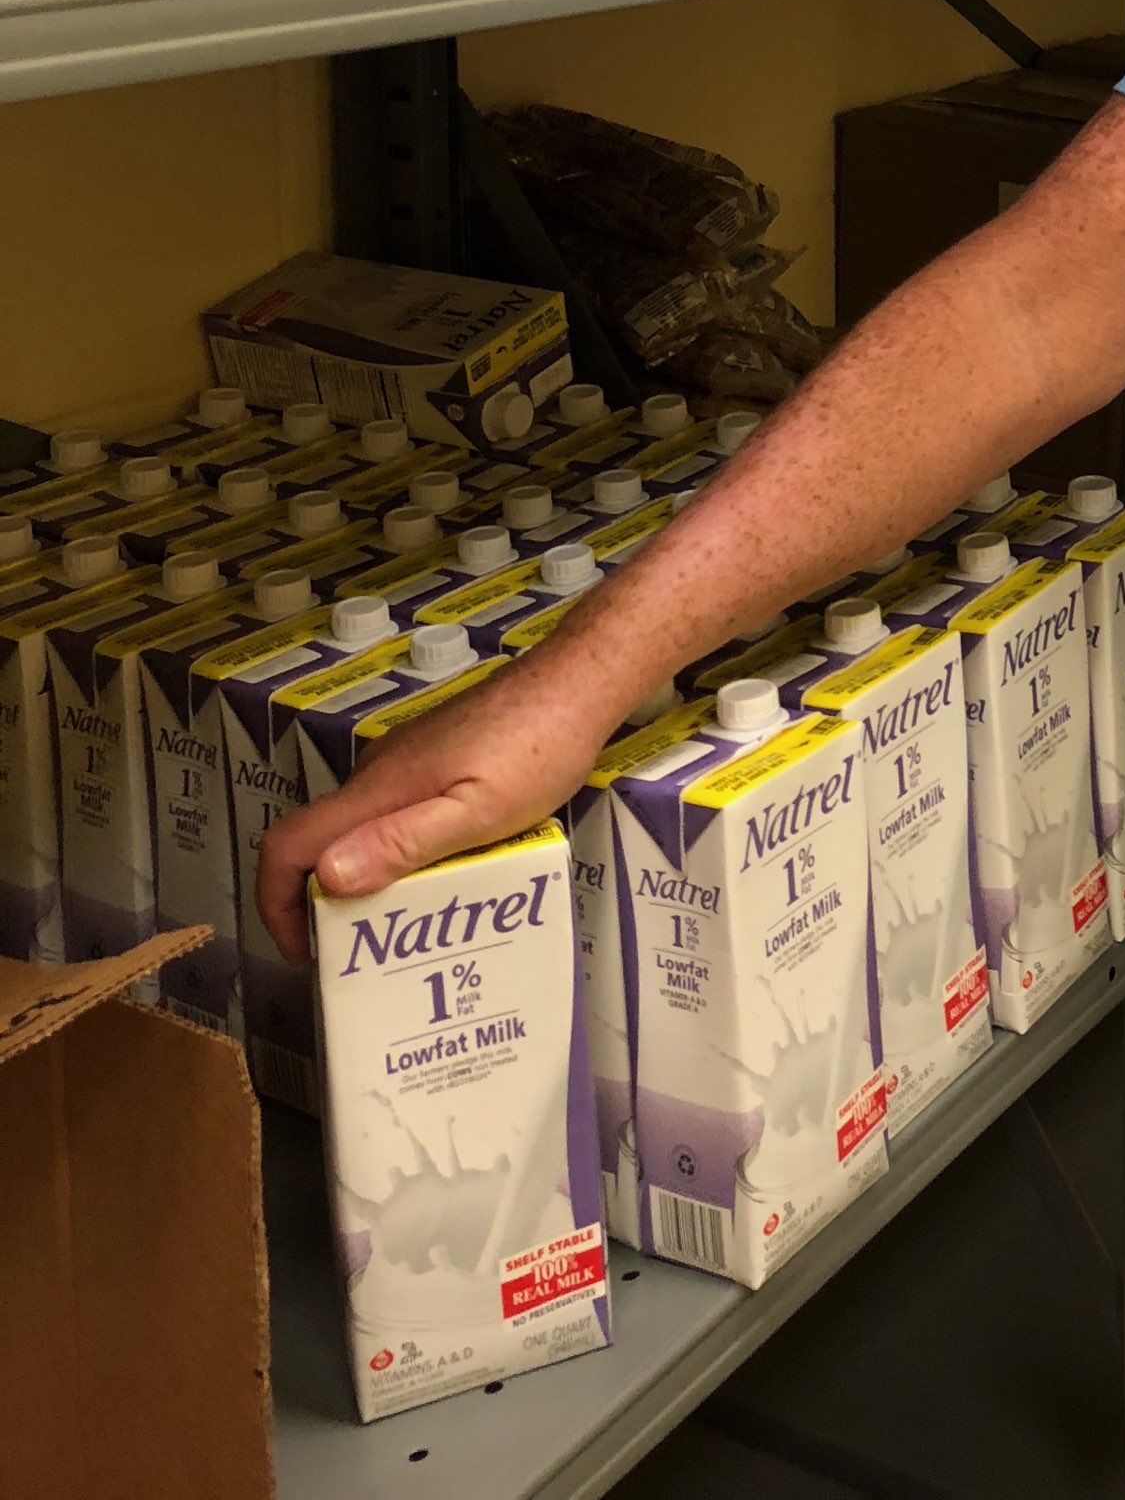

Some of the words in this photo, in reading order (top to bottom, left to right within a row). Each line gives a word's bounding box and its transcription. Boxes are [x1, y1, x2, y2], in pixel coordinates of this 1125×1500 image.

[1001, 589, 1077, 687] Natrel
[862, 661, 954, 763] Natrel
[1029, 665, 1051, 718] 1%
[61, 706, 122, 741] Natrel
[1018, 721, 1048, 760] Lowfat
[1050, 703, 1072, 731] Milk
[156, 728, 218, 770] Natrel
[893, 742, 922, 799] 1%
[235, 760, 301, 800] Natrel
[740, 754, 854, 874] Natrel
[879, 803, 917, 846] Lowfat
[920, 784, 946, 816] Milk
[573, 859, 605, 891] rel
[636, 868, 721, 915] Natrel
[783, 843, 816, 907] 1%
[340, 874, 549, 977] Natrel
[670, 915, 699, 949] 1%
[765, 908, 810, 959] Lowfat
[812, 889, 843, 923] Milk
[656, 954, 710, 981] Lowfat
[667, 972, 700, 993] Milk
[423, 960, 482, 1025] 1%
[456, 992, 482, 1007] Milk
[456, 1004, 475, 1018] Fat
[385, 1032, 468, 1075] Lowfat
[475, 1017, 527, 1050] Milk
[505, 1249, 545, 1273] SHELF
[549, 1229, 594, 1254] STABLE
[530, 1252, 580, 1284] 100%
[512, 1282, 555, 1306] REAL
[557, 1266, 595, 1292] MILK
[512, 1317, 527, 1328] NO
[529, 1288, 596, 1320] PRESERVATIVES
[438, 1354, 447, 1367] A
[463, 1346, 474, 1360] D
